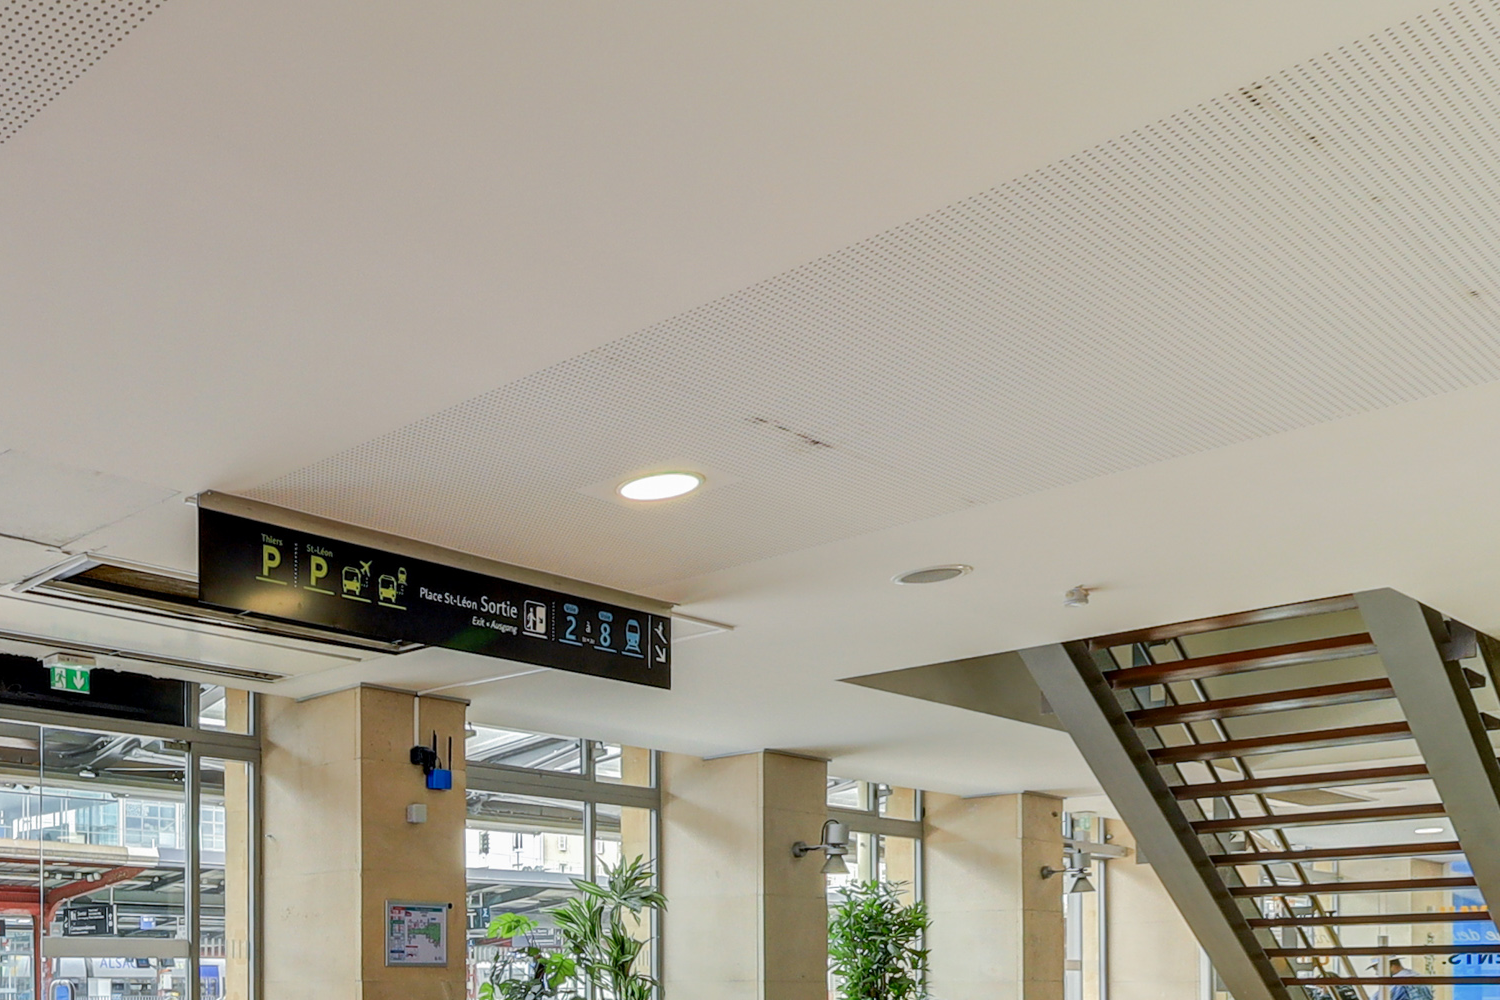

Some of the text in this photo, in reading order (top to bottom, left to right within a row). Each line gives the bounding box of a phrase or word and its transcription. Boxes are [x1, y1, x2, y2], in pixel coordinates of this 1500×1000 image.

[261, 533, 283, 546] Thiers
[306, 544, 334, 558] St-Léon
[263, 544, 281, 576] P
[310, 555, 328, 586] P
[419, 587, 518, 619] Place St-Léon Sortie
[471, 616, 518, 635] Exit Ausgang
[565, 615, 577, 640] 2
[599, 623, 611, 647] 8
